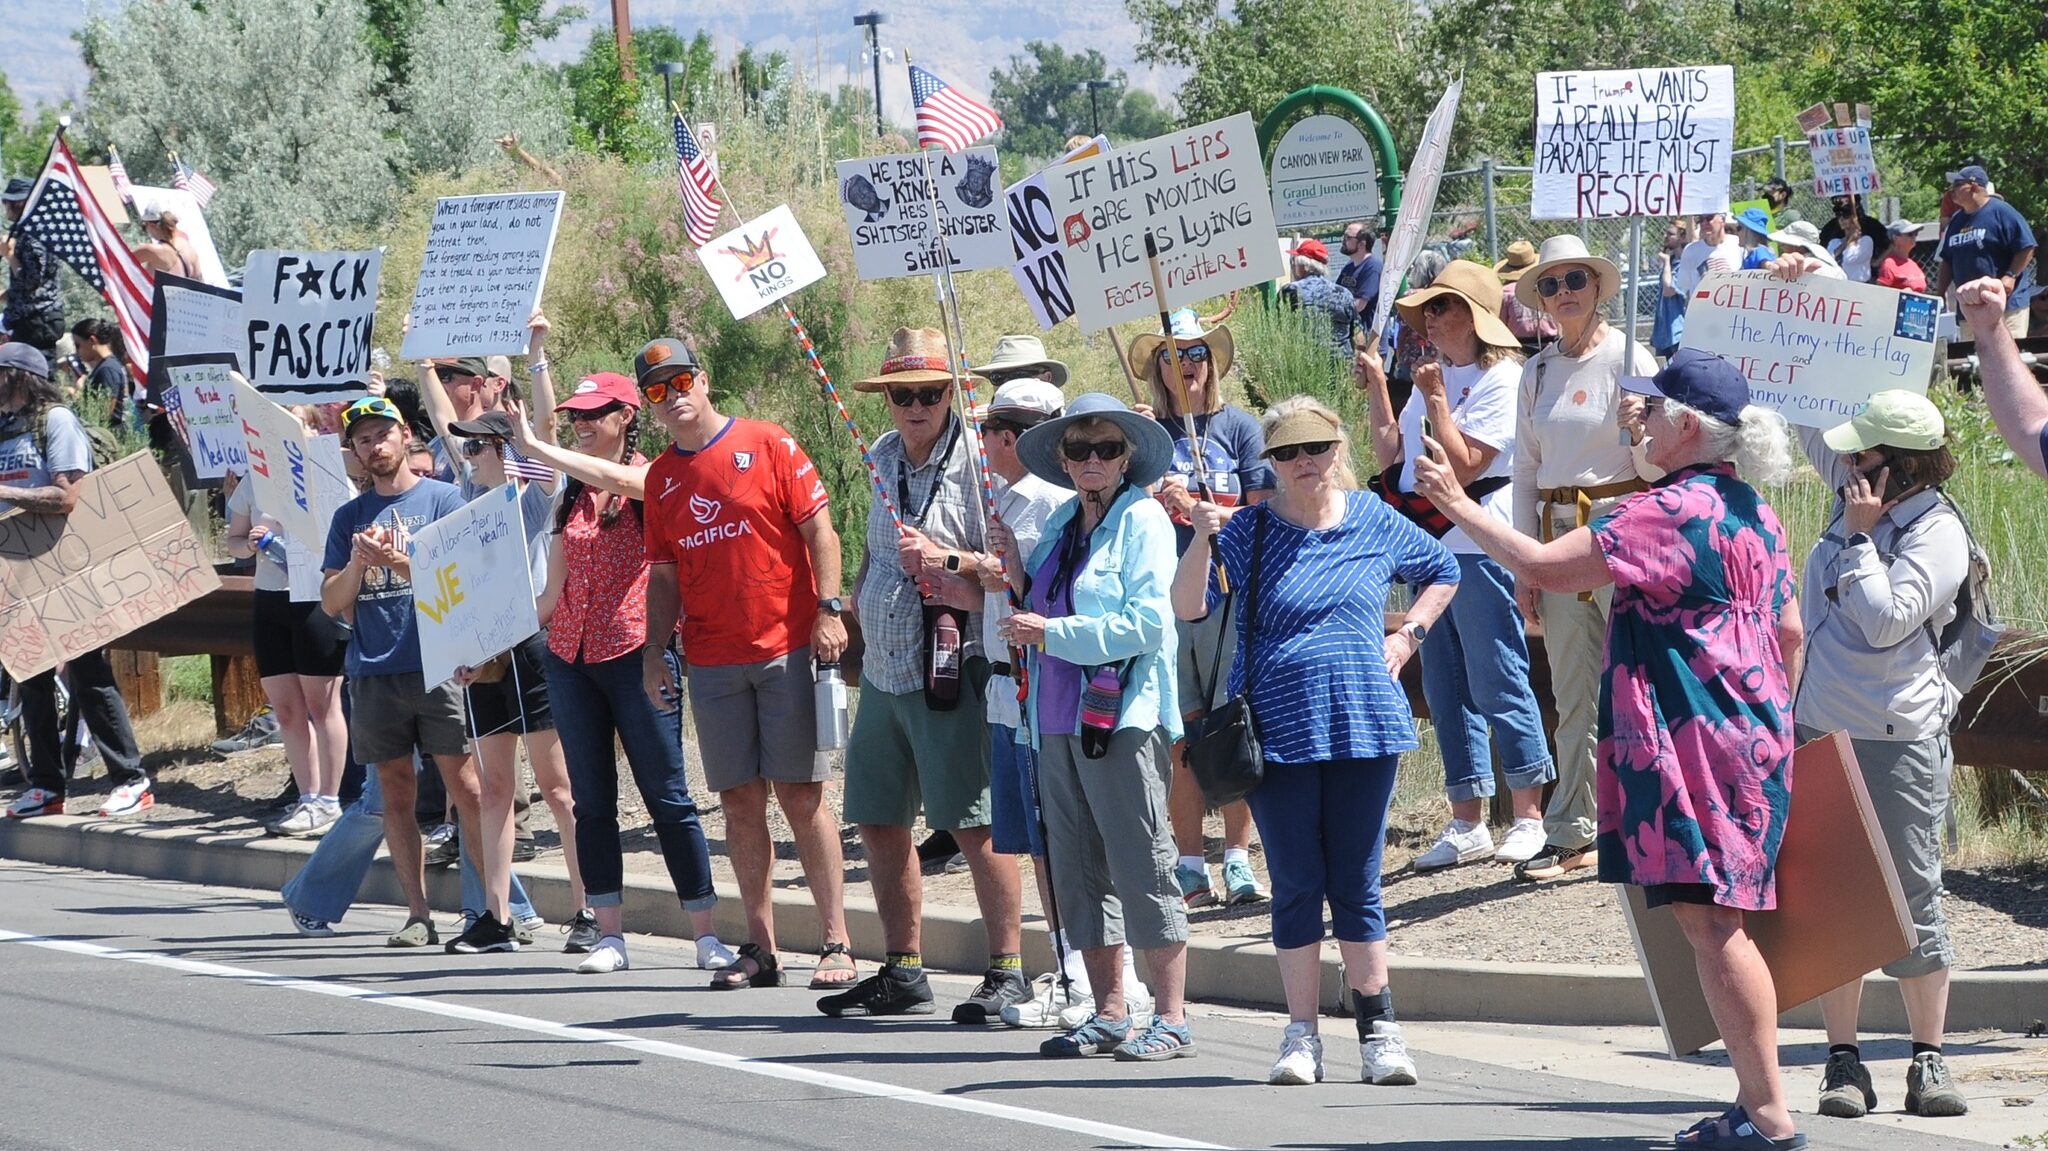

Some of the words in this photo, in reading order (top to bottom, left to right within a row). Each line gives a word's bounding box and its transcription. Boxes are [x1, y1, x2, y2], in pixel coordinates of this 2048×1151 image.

[1551, 75, 1577, 104] IF
[1637, 69, 1709, 103] WANTS
[1299, 133, 1331, 142] Welcome
[1335, 130, 1343, 139] To
[1549, 106, 1565, 142] A
[1574, 104, 1639, 142] REALLY
[1656, 104, 1698, 141] BIG
[1810, 132, 1845, 147] WAKE
[1849, 130, 1866, 144] UP
[869, 161, 892, 184] HE
[941, 155, 956, 176] A
[1280, 152, 1317, 169] CANYON
[1319, 150, 1340, 165] VIEW
[1342, 147, 1363, 163] PARK
[1540, 141, 1612, 174] PARADE
[1622, 140, 1652, 174] HE
[1657, 139, 1720, 173] MUST
[889, 178, 939, 204] KING
[1065, 166, 1096, 202] IF
[1283, 183, 1316, 199] Grand
[1319, 180, 1366, 197] Junction
[1577, 173, 1684, 219] RESIGN
[1817, 174, 1879, 196] AMERICA
[437, 200, 459, 216] When
[462, 204, 467, 213] a
[470, 198, 503, 216] foreigner
[506, 199, 530, 211] resides
[533, 196, 558, 212] among
[899, 204, 928, 220] HE'S
[936, 200, 950, 215] A
[432, 223, 445, 236] you
[450, 221, 456, 229] in
[460, 219, 476, 232] your
[509, 217, 520, 228] do
[526, 217, 541, 227] not
[939, 214, 1002, 236] SHYSTER
[1006, 185, 1060, 262] NO
[426, 251, 438, 264] The
[526, 251, 539, 262] you
[427, 235, 461, 247] mistreat
[1096, 234, 1139, 273] HE
[416, 282, 434, 297] Love
[460, 284, 467, 293] as
[470, 284, 483, 297] you
[487, 281, 500, 292] love
[749, 261, 786, 289] NO
[758, 276, 794, 299] KINGS
[1022, 249, 1076, 326] KI
[413, 315, 419, 328] I
[455, 314, 470, 324] Lord
[476, 315, 491, 327] your
[424, 302, 436, 314] you
[492, 300, 498, 309] in
[1713, 284, 1864, 327] CELEBRATE
[248, 312, 373, 380] FASCISM
[446, 331, 483, 345] Leviticus
[1728, 314, 1765, 343] the
[1770, 321, 1822, 354] Army
[1830, 332, 1866, 357] the
[1870, 336, 1911, 376] flag
[1791, 353, 1812, 366] and
[195, 429, 249, 469] Medicai
[242, 418, 270, 478] LET
[78, 452, 155, 520] VET
[283, 440, 308, 512] RING
[417, 539, 439, 570] Our
[471, 509, 490, 537] their
[479, 510, 509, 547] wealth
[678, 519, 752, 550] PACIFICA
[28, 533, 91, 587] NO
[27, 549, 153, 634] KINGS
[416, 561, 465, 625] WE
[58, 608, 119, 656] RESIST
[122, 575, 204, 626] FASISM
